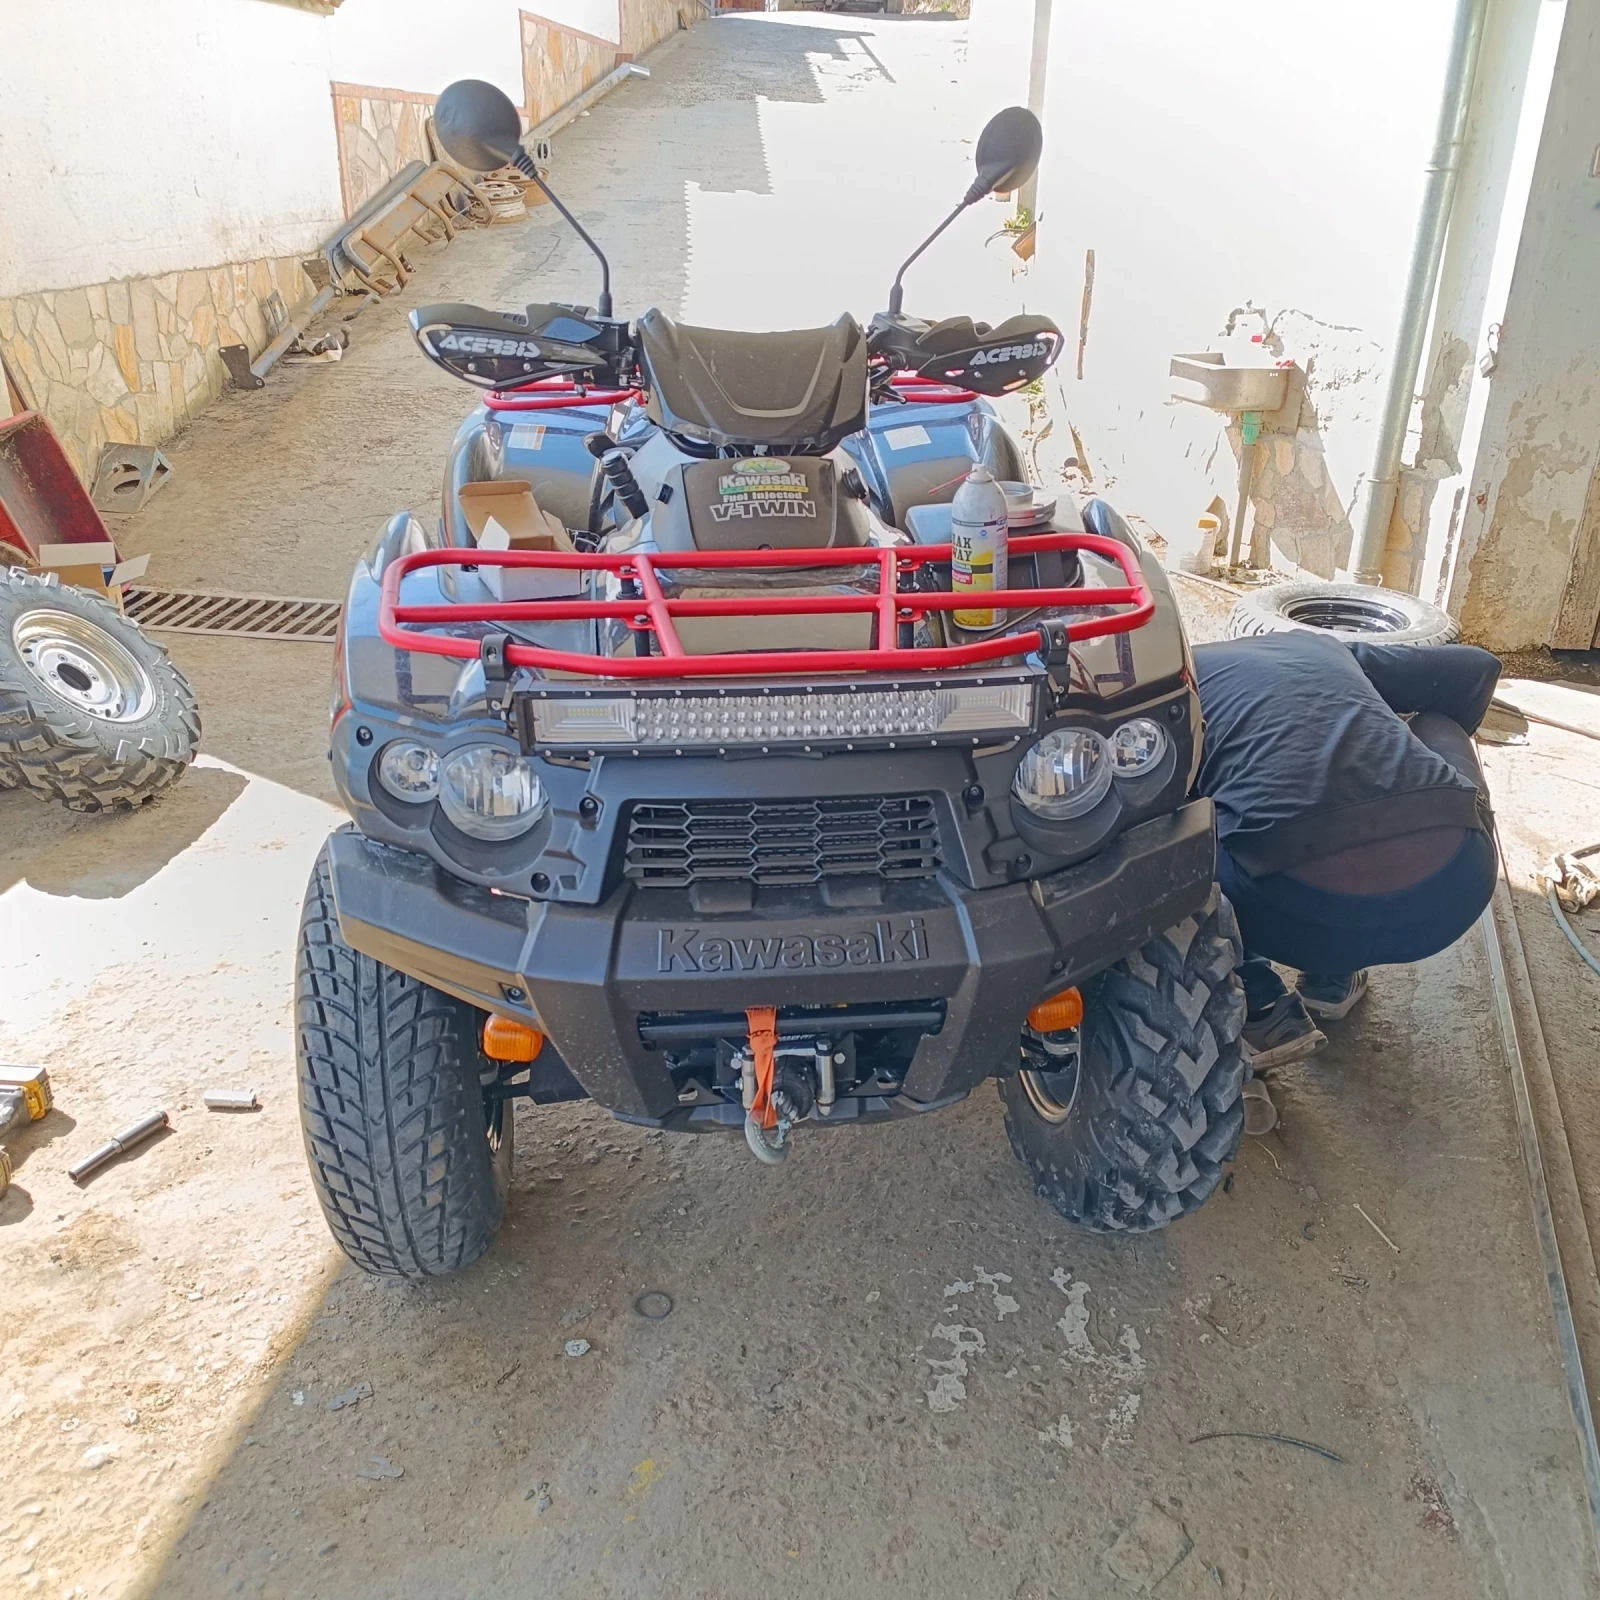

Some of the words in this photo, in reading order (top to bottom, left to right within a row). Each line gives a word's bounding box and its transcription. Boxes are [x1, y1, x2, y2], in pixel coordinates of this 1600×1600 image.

[721, 473, 806, 489] Kawasaki
[723, 492, 749, 503] Fuel
[752, 491, 802, 501] Injected
[710, 499, 817, 522] V-TWIN
[658, 917, 930, 973] Kawasaki
